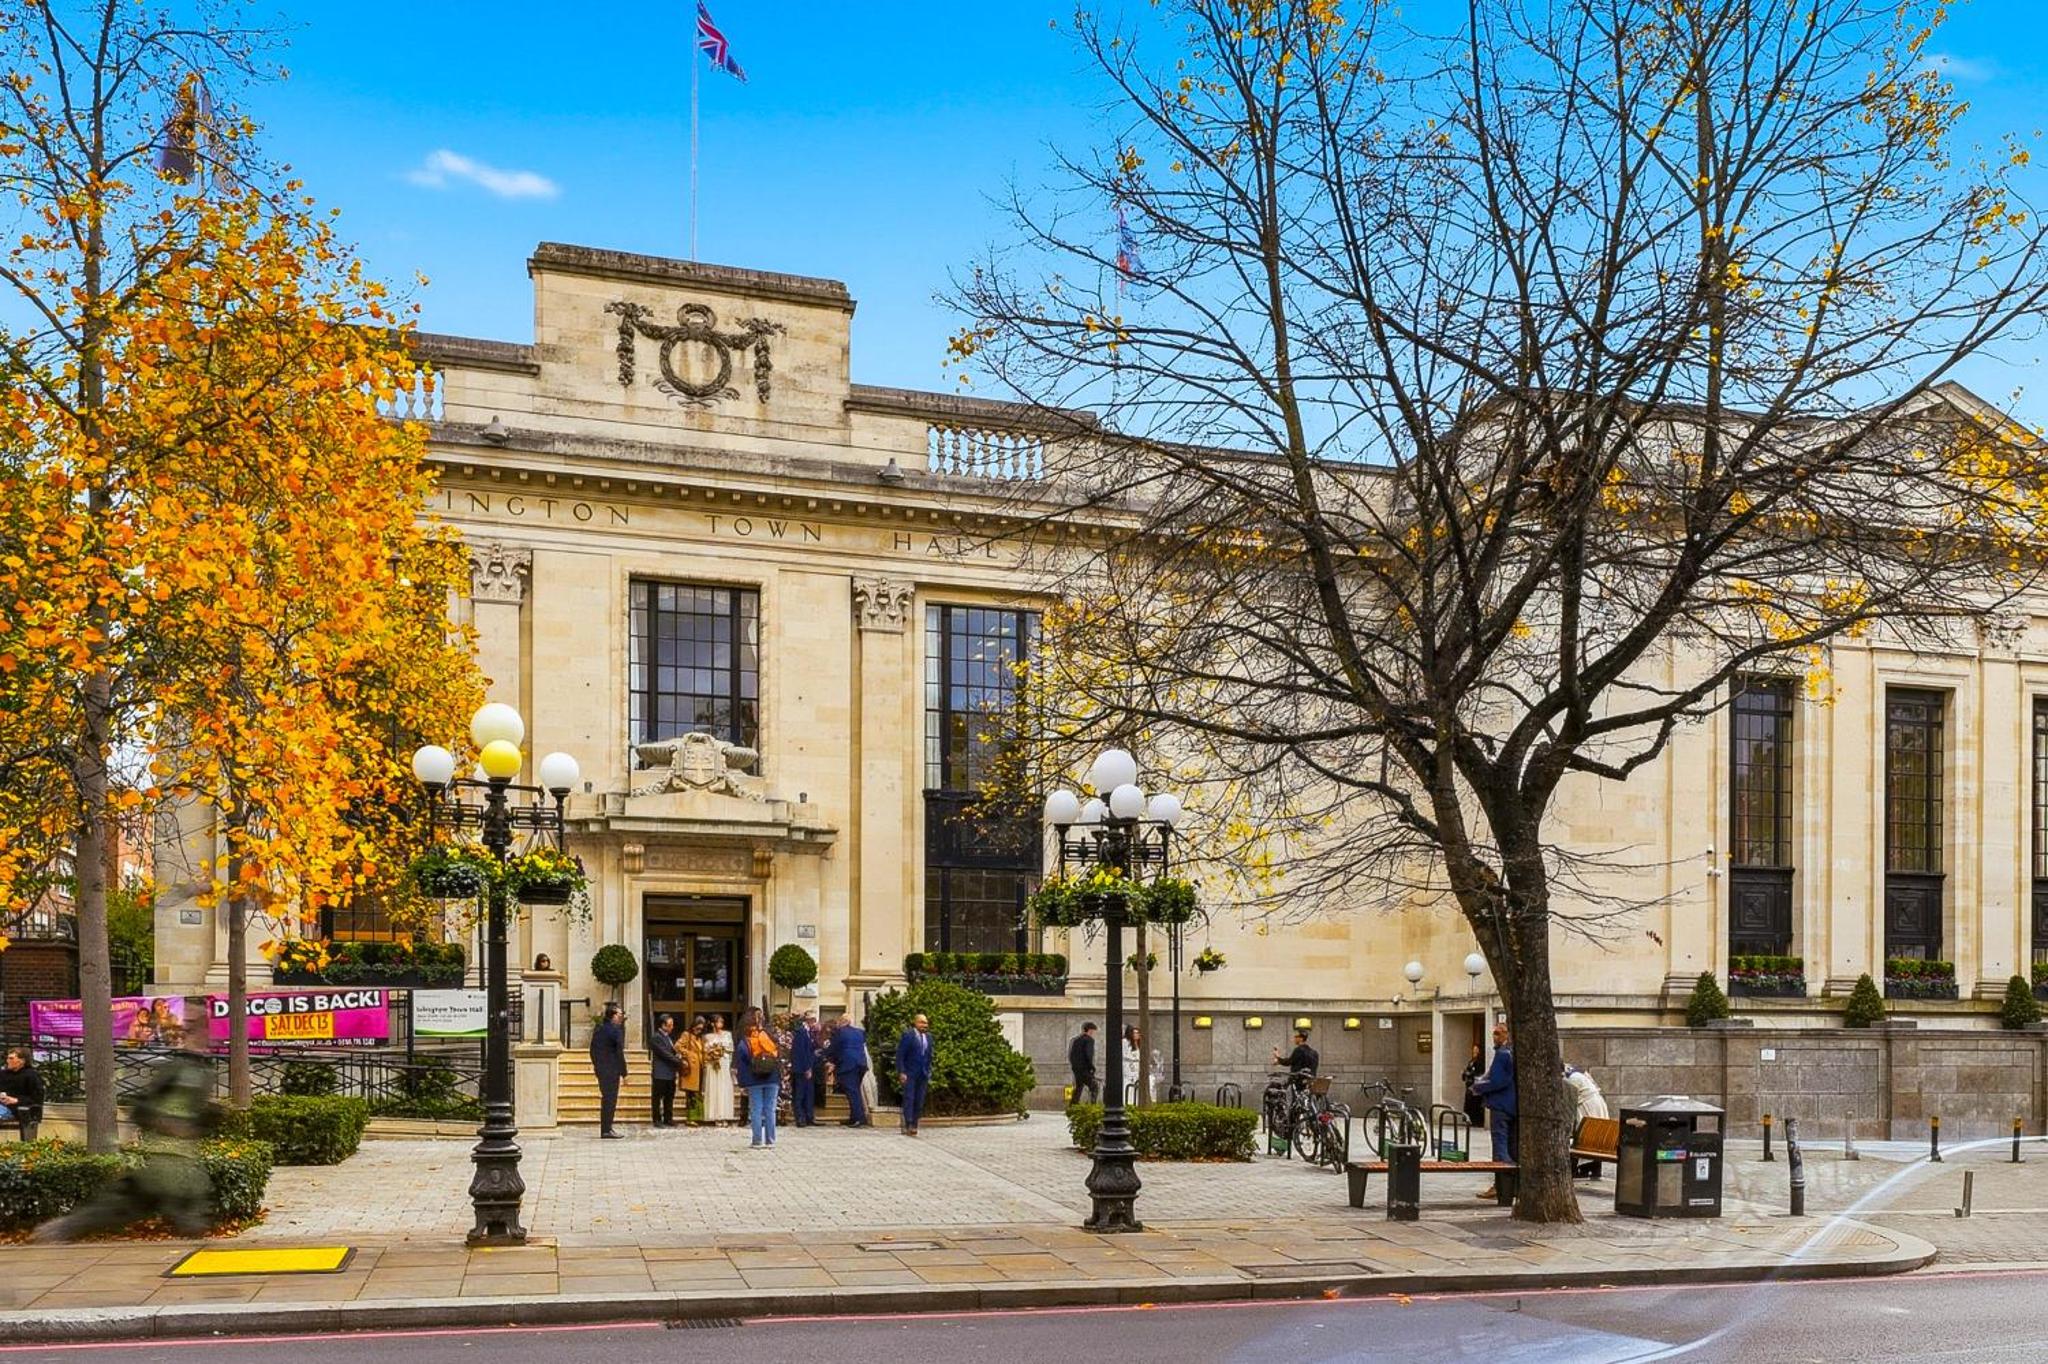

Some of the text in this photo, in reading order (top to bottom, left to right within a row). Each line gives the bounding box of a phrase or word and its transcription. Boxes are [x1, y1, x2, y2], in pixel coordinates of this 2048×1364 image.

[704, 515, 822, 542] TOWN
[893, 531, 998, 559] HALL
[214, 990, 380, 1017] DCO IS BACK!
[271, 1013, 329, 1032] SAT DEC 13
